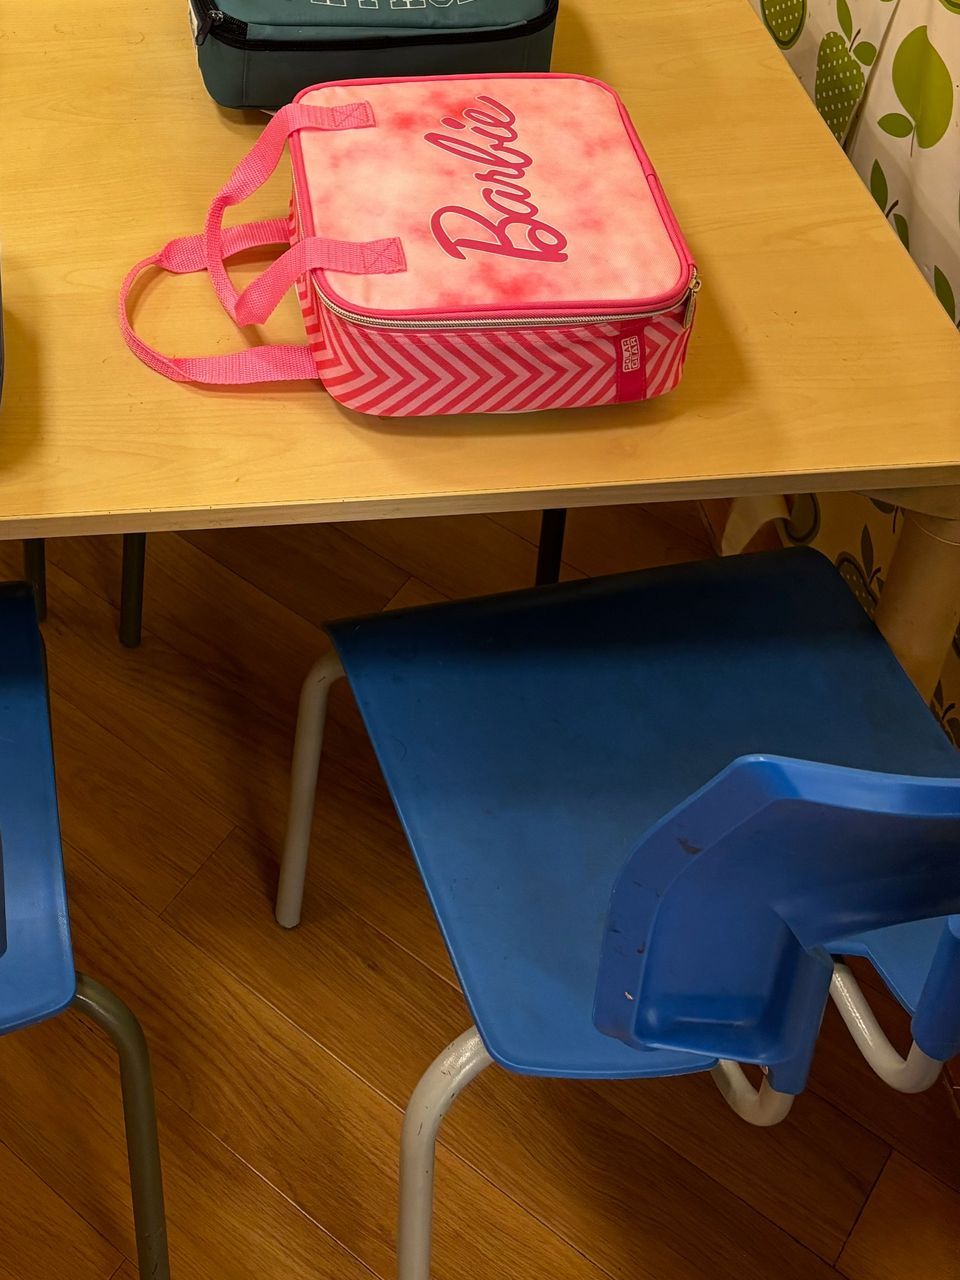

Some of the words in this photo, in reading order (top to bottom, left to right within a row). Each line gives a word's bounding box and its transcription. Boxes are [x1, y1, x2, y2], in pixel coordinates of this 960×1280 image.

[423, 94, 569, 263] Barbie
[622, 339, 631, 371] POLAR
[630, 336, 639, 370] GEAR
